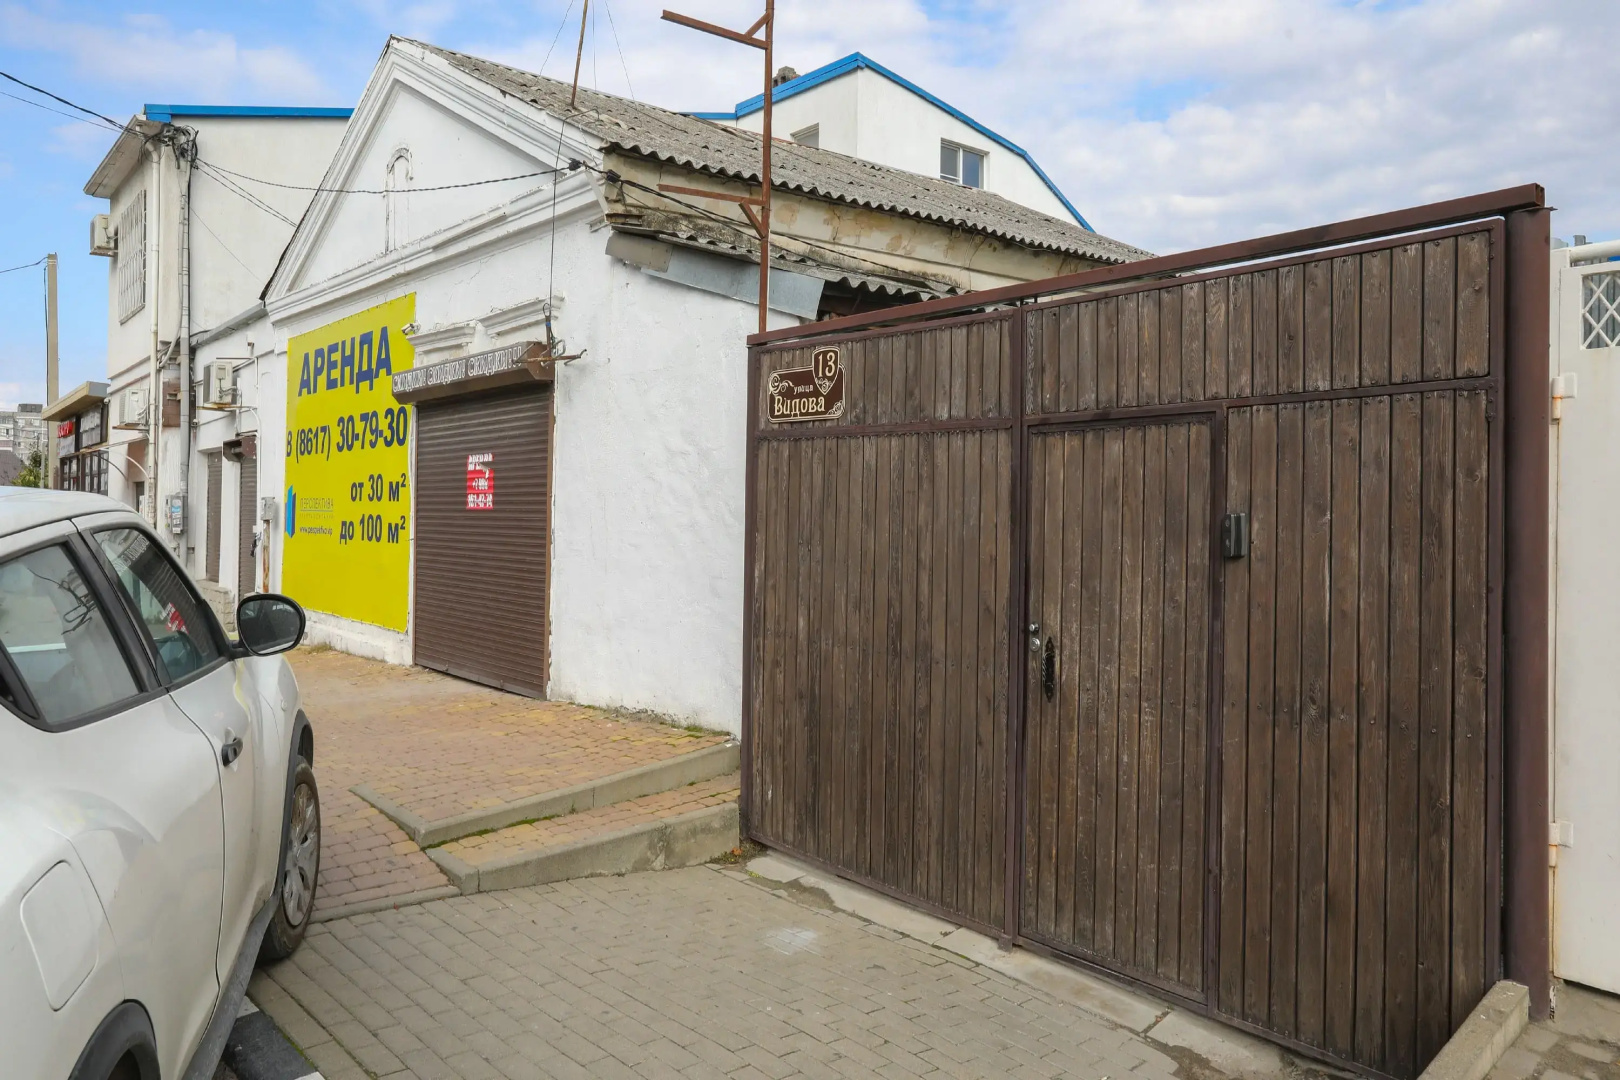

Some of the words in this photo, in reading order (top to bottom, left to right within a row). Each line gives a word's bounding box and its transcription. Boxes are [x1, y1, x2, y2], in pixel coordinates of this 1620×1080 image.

[298, 326, 392, 397] АРЕНДА
[427, 359, 466, 386] СКИДКИ!
[818, 352, 836, 377] 13
[794, 385, 814, 395] улица
[774, 396, 826, 418] Видова
[296, 425, 331, 463] (8617)
[336, 406, 408, 452] 30-79-30
[350, 482, 364, 502] от
[367, 474, 383, 502] 30
[340, 520, 354, 544] до
[359, 514, 382, 542] 100
